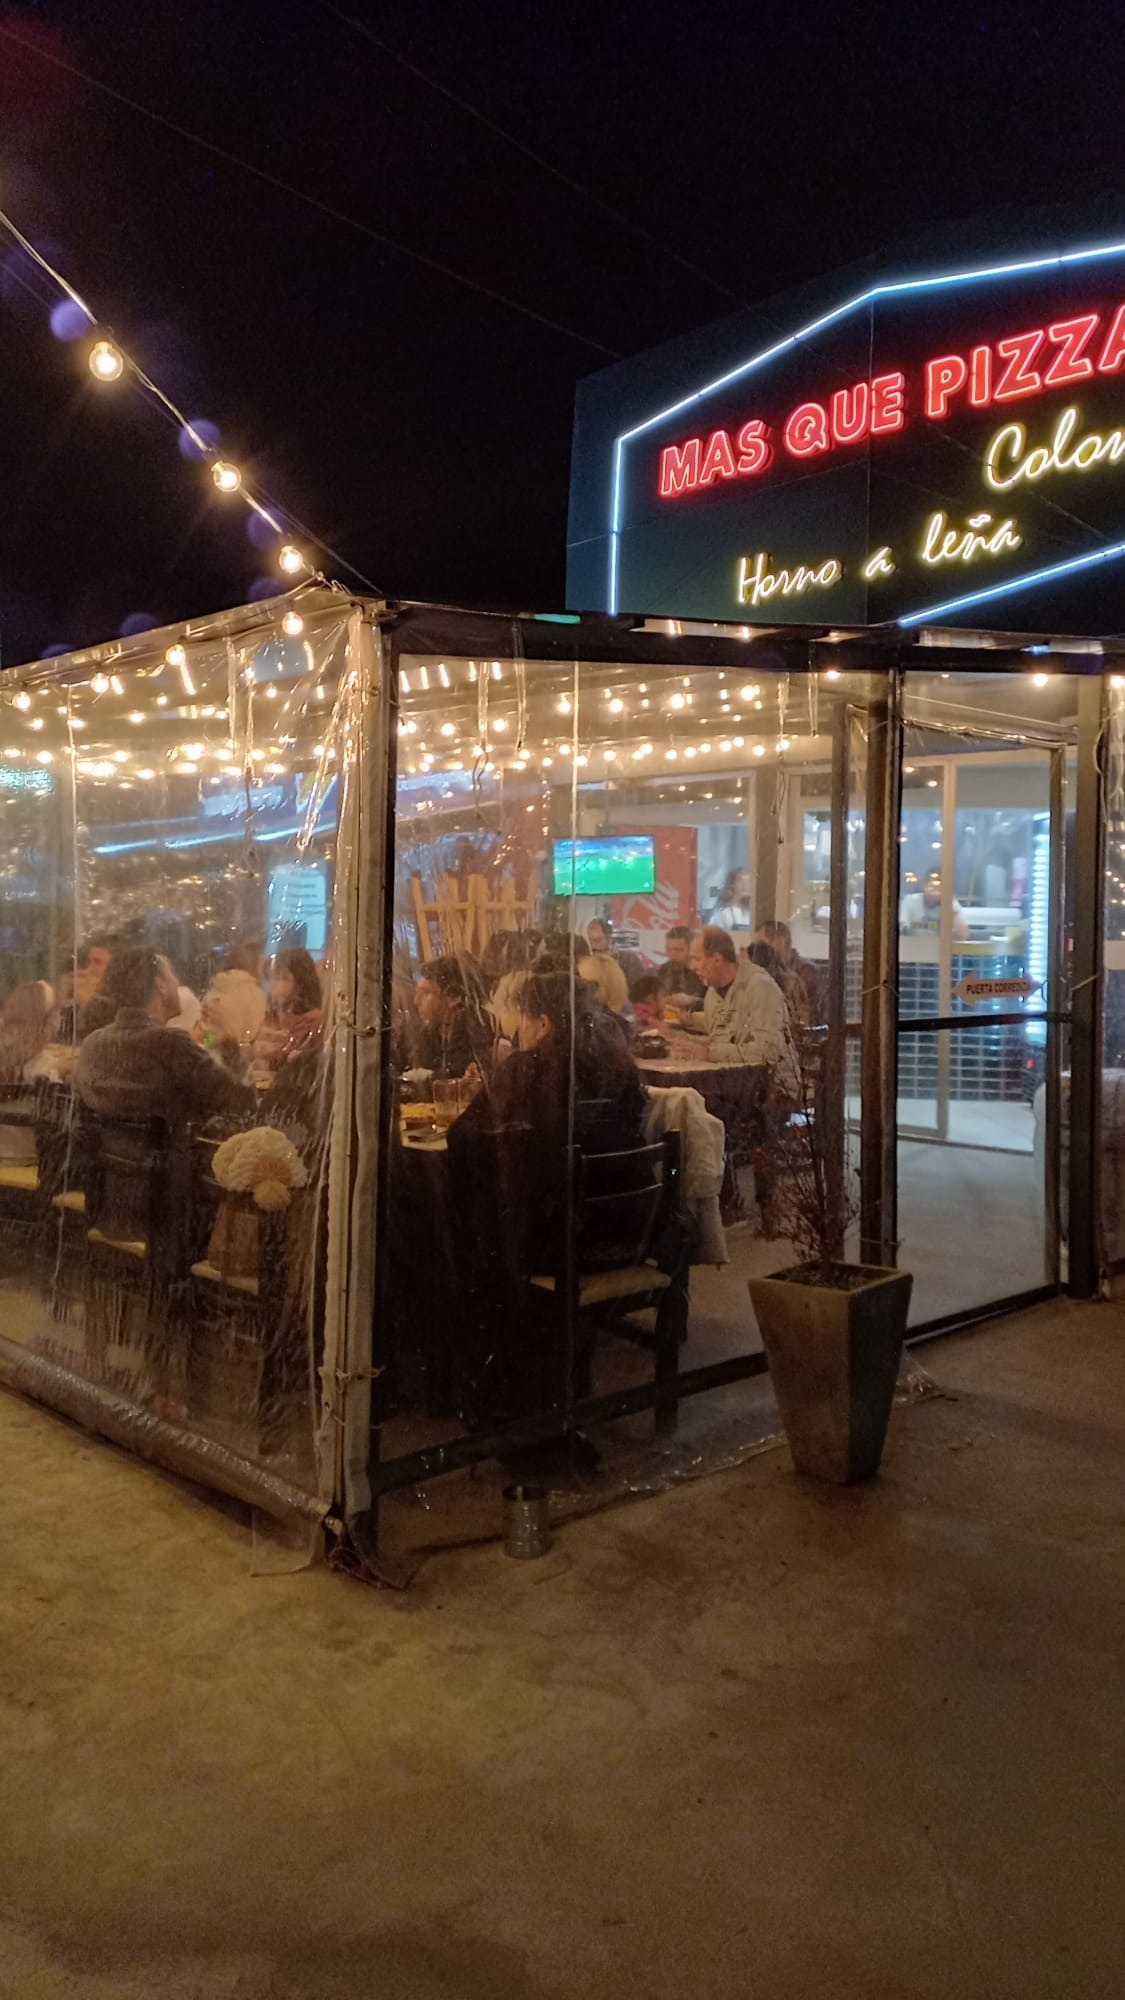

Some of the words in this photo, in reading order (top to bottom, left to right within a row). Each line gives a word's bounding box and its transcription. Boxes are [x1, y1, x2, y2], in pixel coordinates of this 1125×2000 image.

[660, 418, 769, 496] MAS
[786, 371, 904, 455] QUE
[738, 551, 840, 606] Horno
[862, 546, 895, 579] a
[922, 511, 1022, 563] leña
[966, 983, 992, 995] PUERTA
